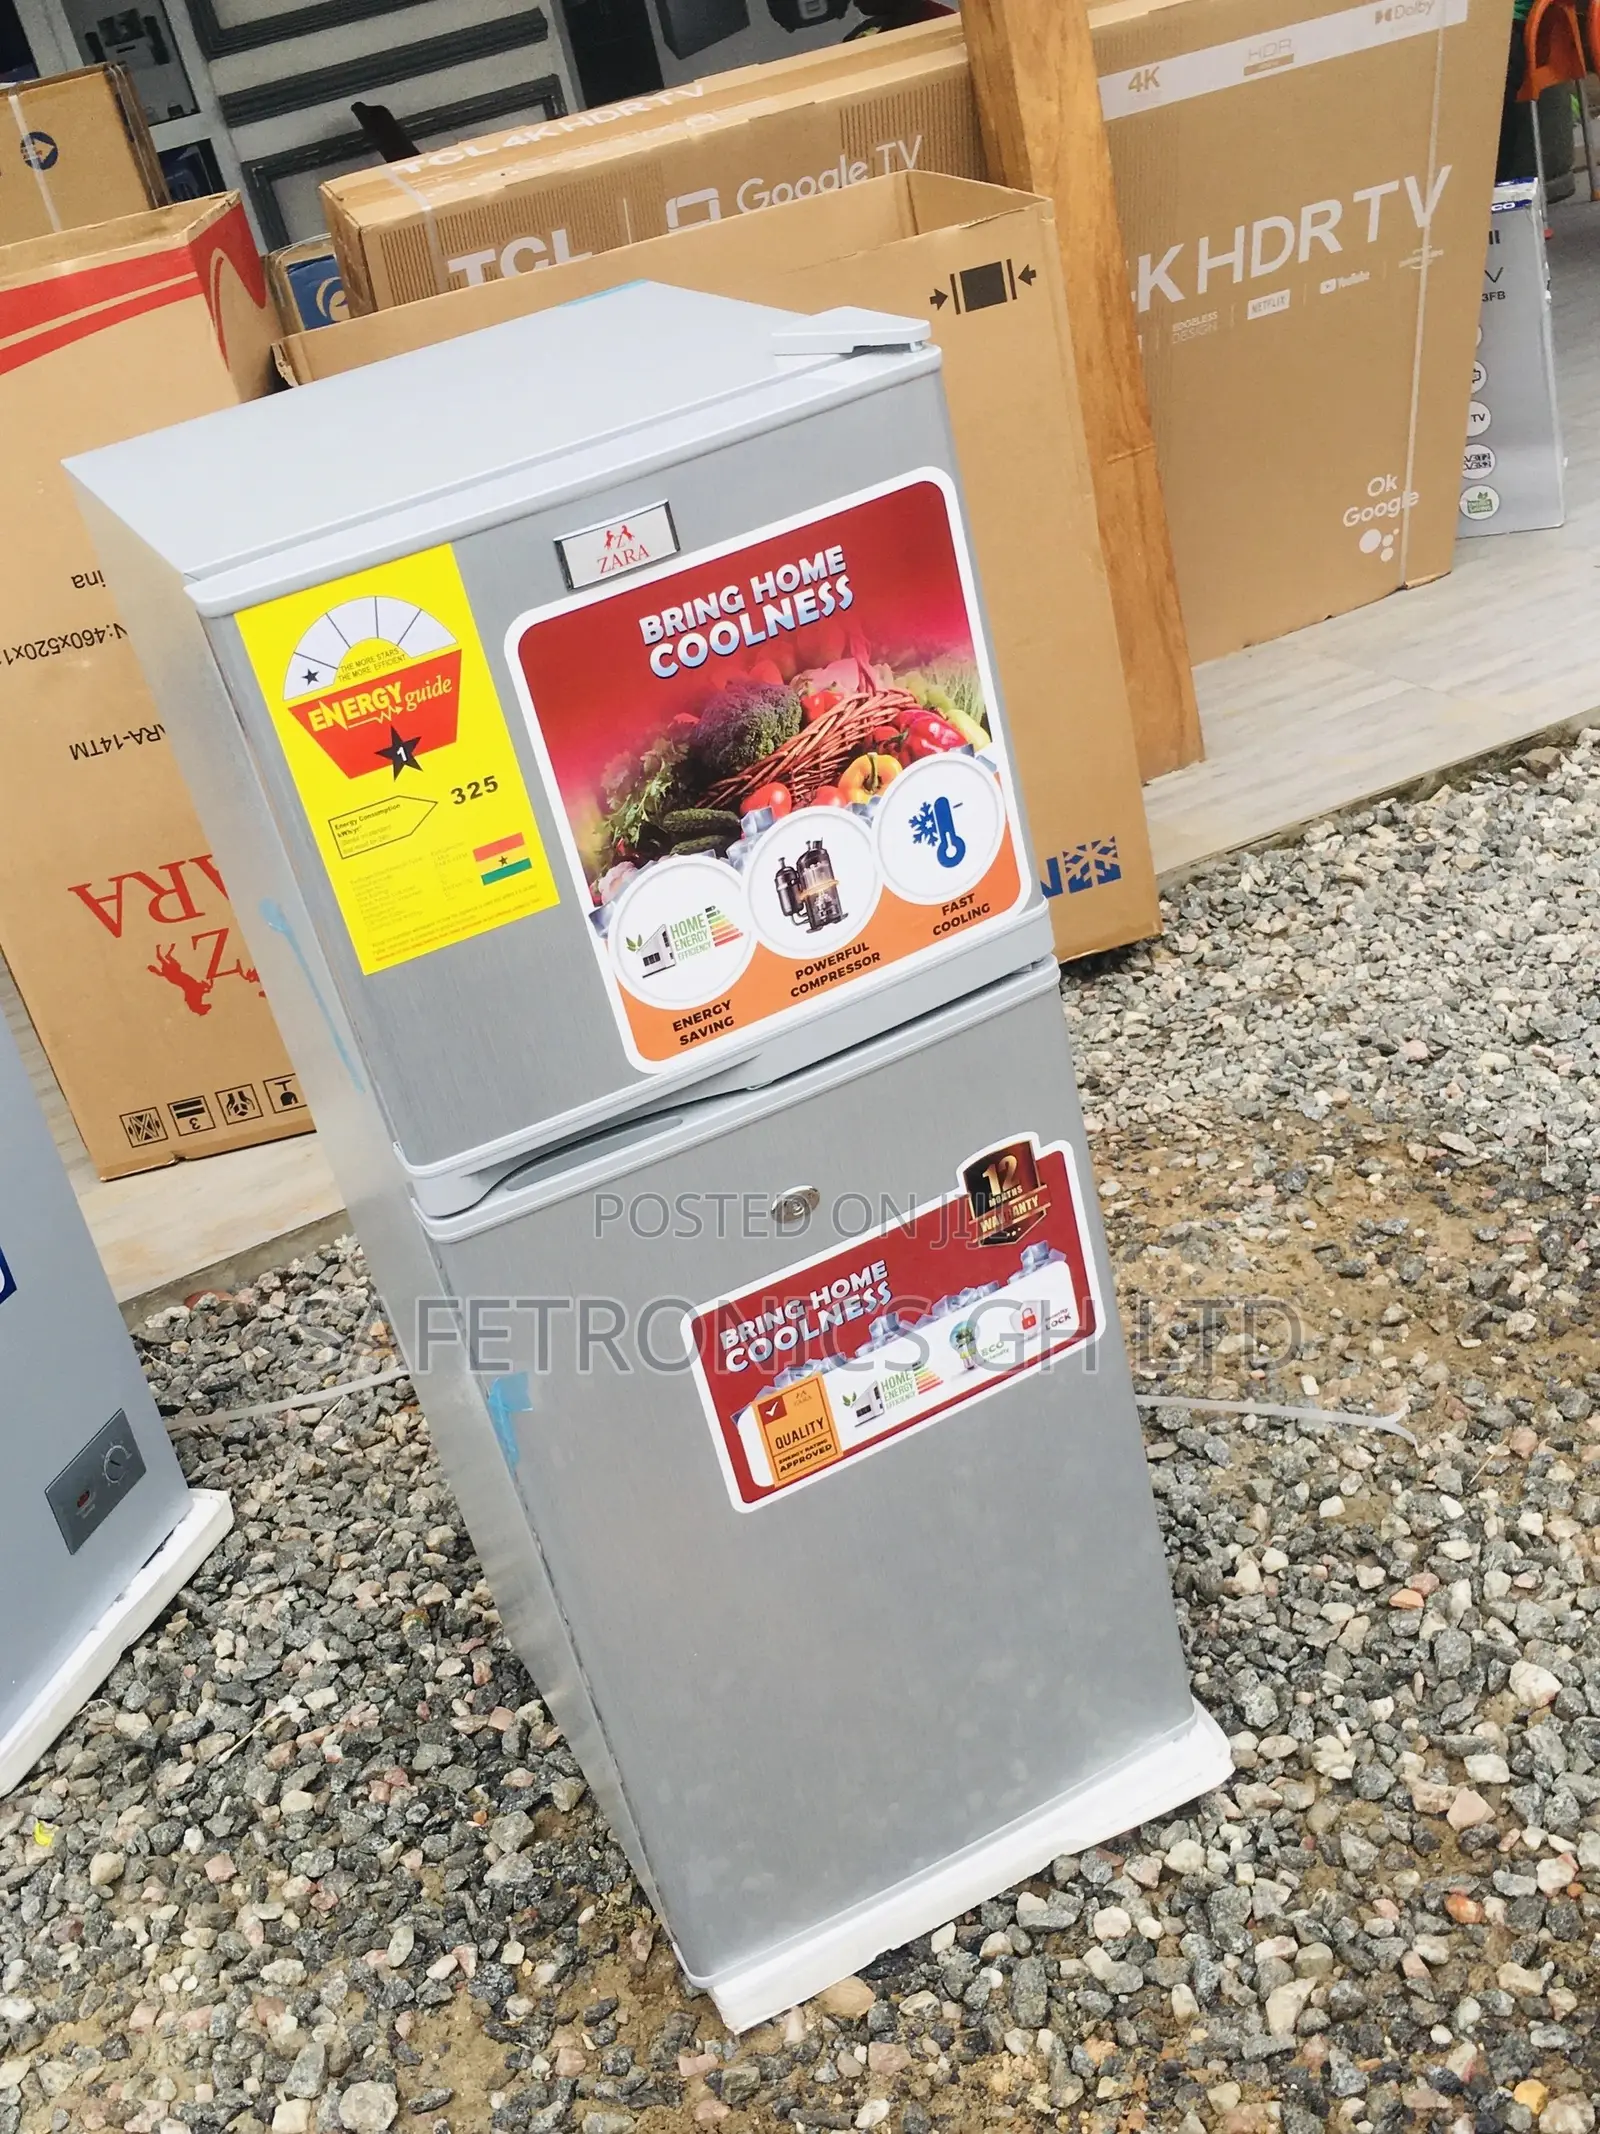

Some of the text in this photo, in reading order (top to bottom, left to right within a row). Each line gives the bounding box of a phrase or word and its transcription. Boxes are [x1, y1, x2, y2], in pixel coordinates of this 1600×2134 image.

[1128, 66, 1162, 93] 4K
[393, 145, 499, 174] TCL
[502, 126, 562, 149] 4K
[557, 100, 652, 133] HDR
[652, 84, 706, 107] TV
[876, 134, 923, 175] TV
[1491, 202, 1516, 213] CO
[1126, 164, 1453, 313] K HDR TV
[449, 228, 593, 288] TCL
[1250, 295, 1289, 313] NETFLIX
[1482, 290, 1506, 302] 3FB
[1367, 474, 1398, 497] Ok
[1343, 491, 1419, 527] Google
[597, 543, 650, 574] ZARA
[70, 569, 107, 589] ina
[638, 544, 848, 646] BRING HOME
[649, 574, 854, 679] COOLNESS
[338, 654, 406, 683] THE MORE EFFICIENT
[340, 648, 400, 673] THE MORE STARS
[308, 675, 453, 732] ENERGY guide
[68, 723, 166, 761] RA-14TM
[396, 746, 408, 762] 1
[451, 775, 498, 805] 325
[335, 803, 401, 831] Energy Consumption
[941, 893, 976, 916] FAST
[670, 913, 706, 940] HOME
[932, 903, 991, 937] COOLING
[674, 930, 709, 952] ENERGY
[678, 942, 713, 961] EFFICIENCY
[790, 952, 881, 999] COMPRESSOR
[795, 941, 870, 981] POWERFUL
[672, 999, 732, 1033] ENERGY
[679, 1016, 735, 1047] SAVING
[982, 1155, 1018, 1197] 12
[719, 1259, 889, 1351] BRING HOME
[725, 1280, 892, 1373] COOLNESS
[1045, 1313, 1072, 1331] LOCK
[881, 1370, 913, 1393] HOME
[883, 1383, 914, 1401] ENERGY
[774, 1417, 825, 1450] QUALITY
[778, 1438, 829, 1465] ENERGY RATING
[779, 1443, 832, 1473] APPROVED
